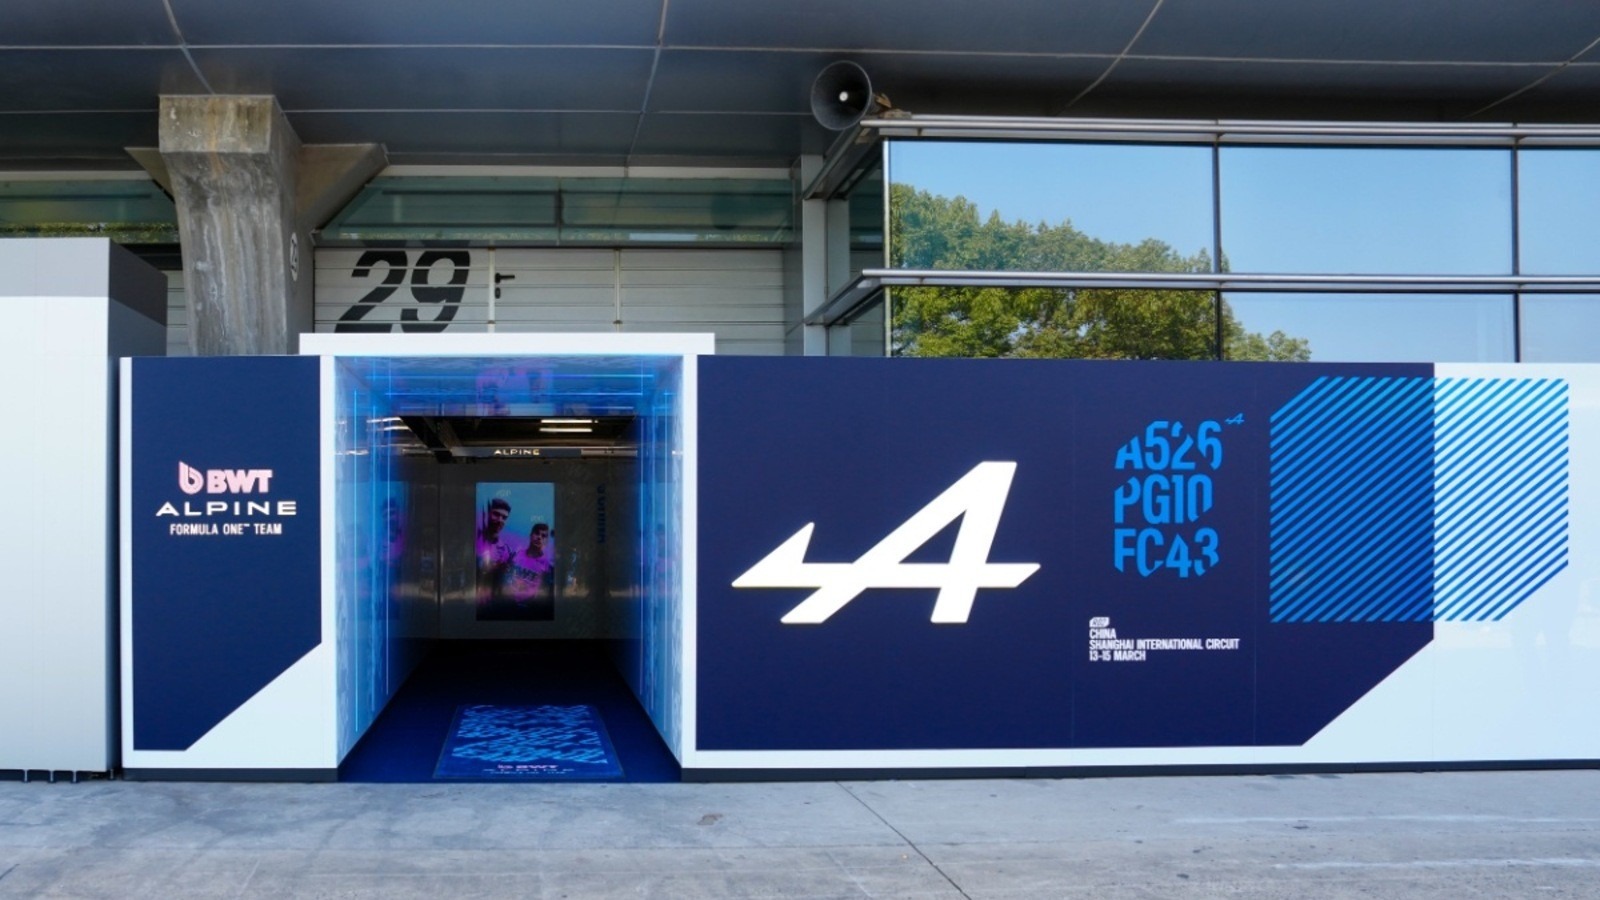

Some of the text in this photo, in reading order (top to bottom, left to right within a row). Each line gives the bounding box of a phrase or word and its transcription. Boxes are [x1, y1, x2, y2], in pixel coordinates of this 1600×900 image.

[334, 250, 470, 333] 29
[206, 469, 273, 494] BWT
[1114, 473, 1213, 525] PG10
[155, 501, 297, 517] ALPINE
[169, 523, 219, 535] FORMULA
[254, 523, 283, 535] TEAM
[1114, 527, 1220, 578] FC43
[1089, 628, 1117, 639] CHINA
[1089, 638, 1240, 650] SHANGHAI INTERNATIONAL CIRCUIT
[1089, 650, 1147, 661] 13-15 MARCH
